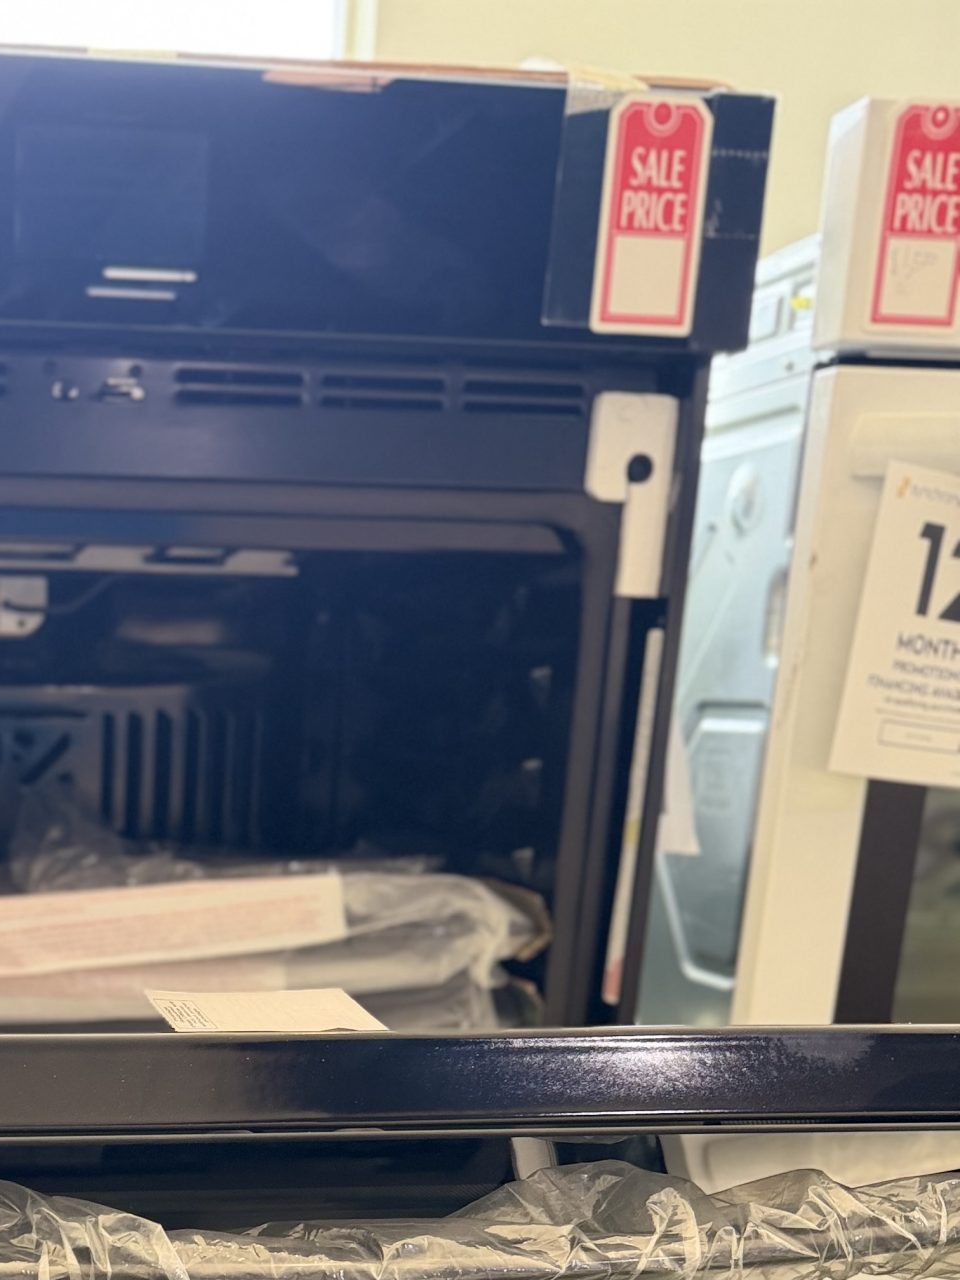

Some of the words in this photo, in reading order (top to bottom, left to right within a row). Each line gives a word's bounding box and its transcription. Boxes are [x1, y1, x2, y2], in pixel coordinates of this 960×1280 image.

[628, 146, 687, 189] SALE
[904, 149, 960, 191] SALE
[619, 189, 688, 232] PRICE
[893, 193, 960, 233] PRICE
